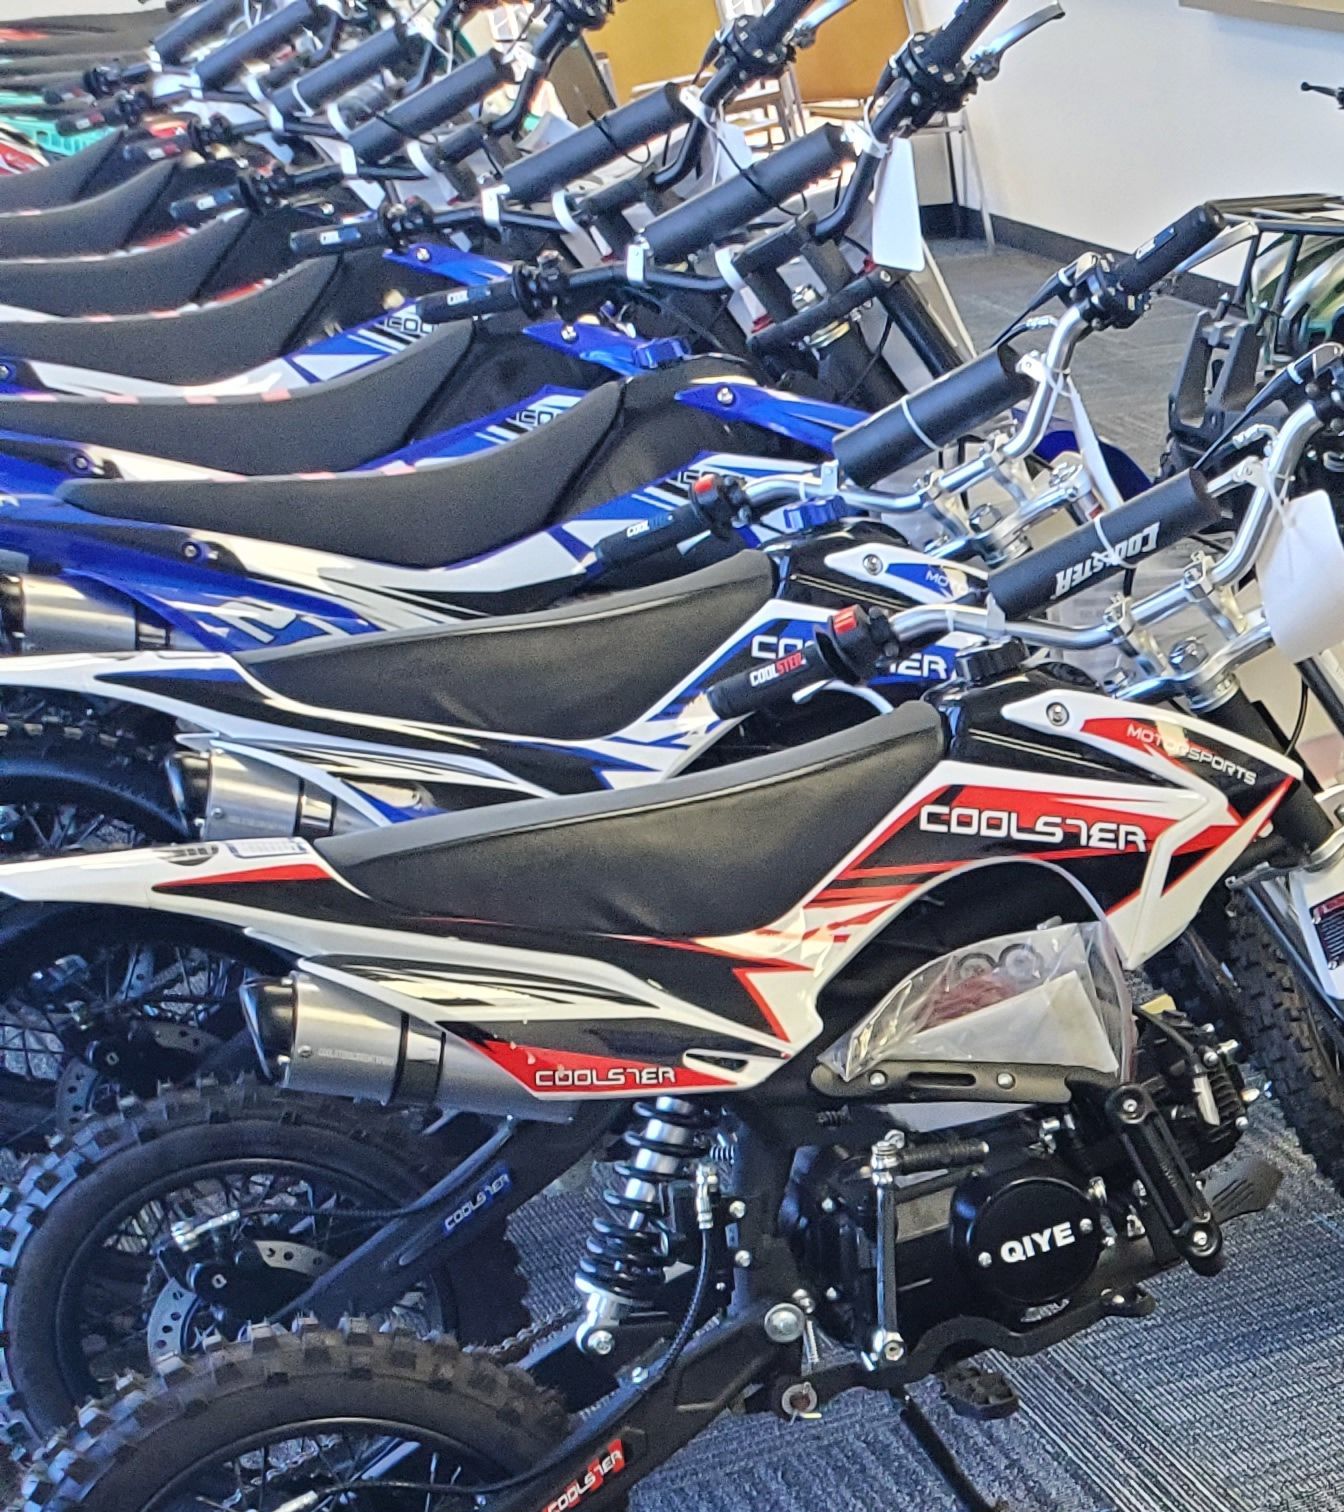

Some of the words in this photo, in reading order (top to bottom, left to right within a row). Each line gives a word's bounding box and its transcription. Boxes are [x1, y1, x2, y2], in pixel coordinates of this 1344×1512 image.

[919, 804, 1147, 852] COOLSTER
[534, 1067, 676, 1087] COOLSTER
[1000, 1221, 1075, 1263] QIYE
